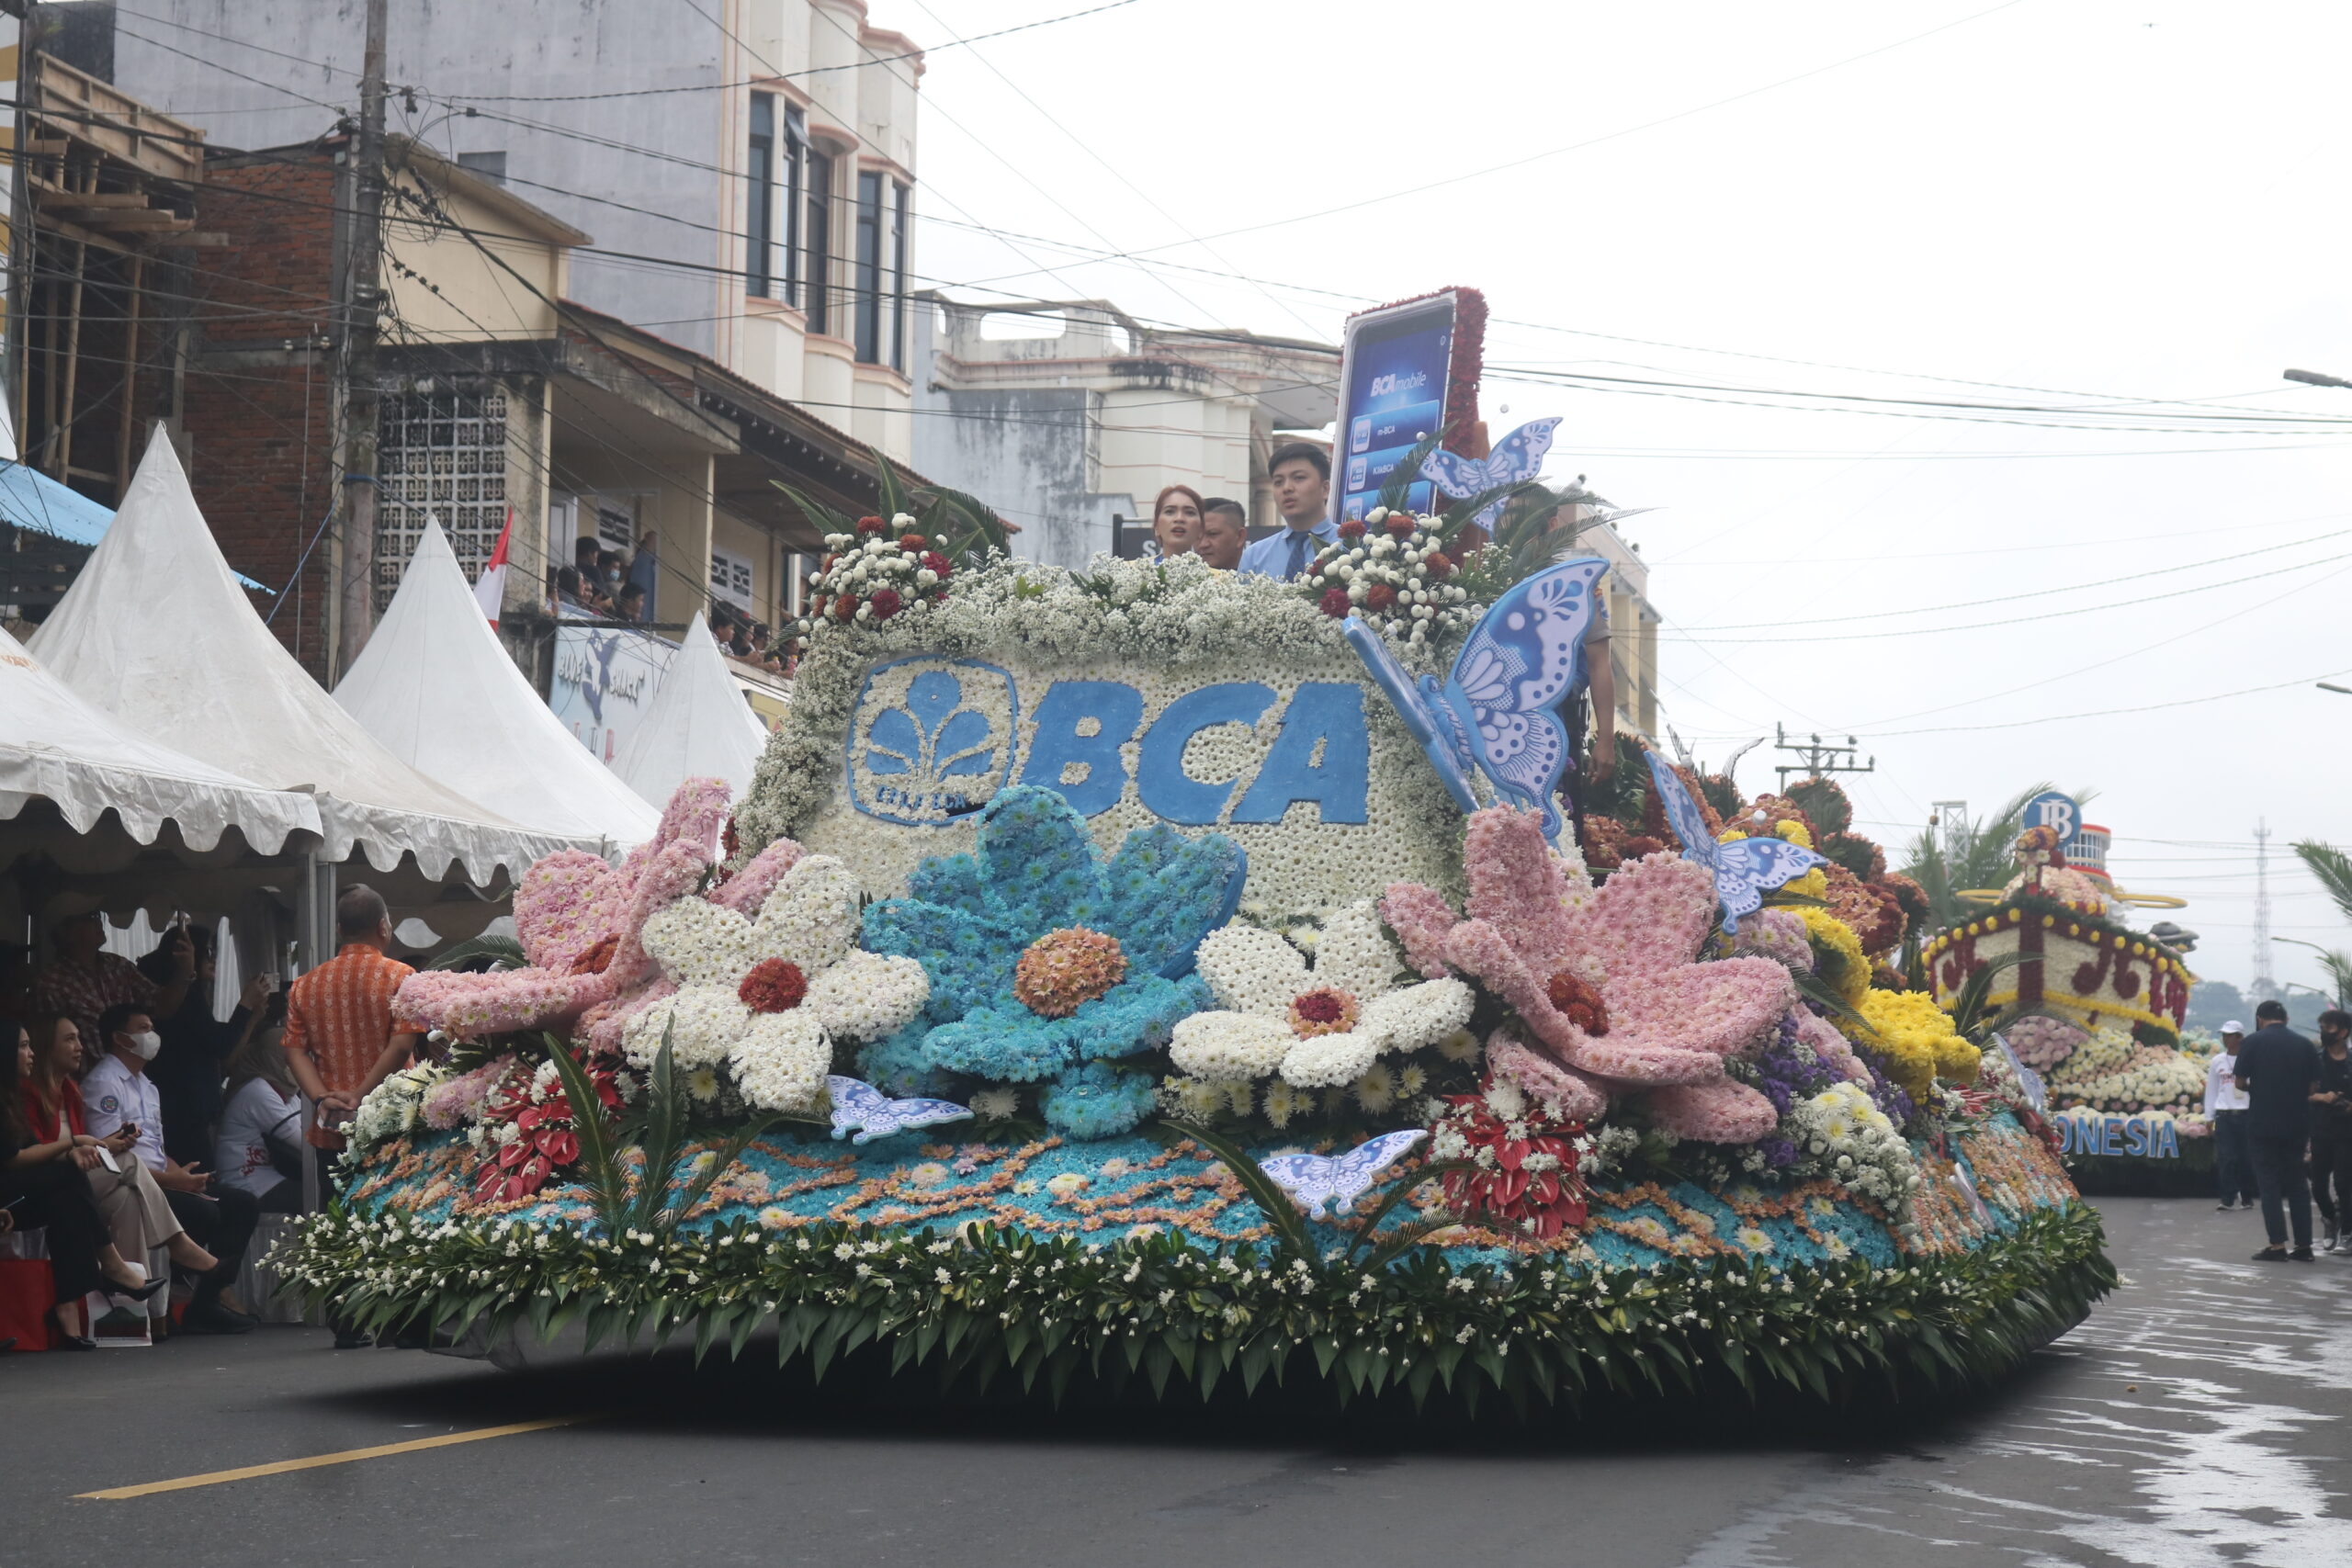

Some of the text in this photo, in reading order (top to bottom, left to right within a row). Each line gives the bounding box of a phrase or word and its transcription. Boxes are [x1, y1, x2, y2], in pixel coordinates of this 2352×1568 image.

[1371, 371, 1427, 397] BCA mobile
[1002, 681, 1370, 825] BCA
